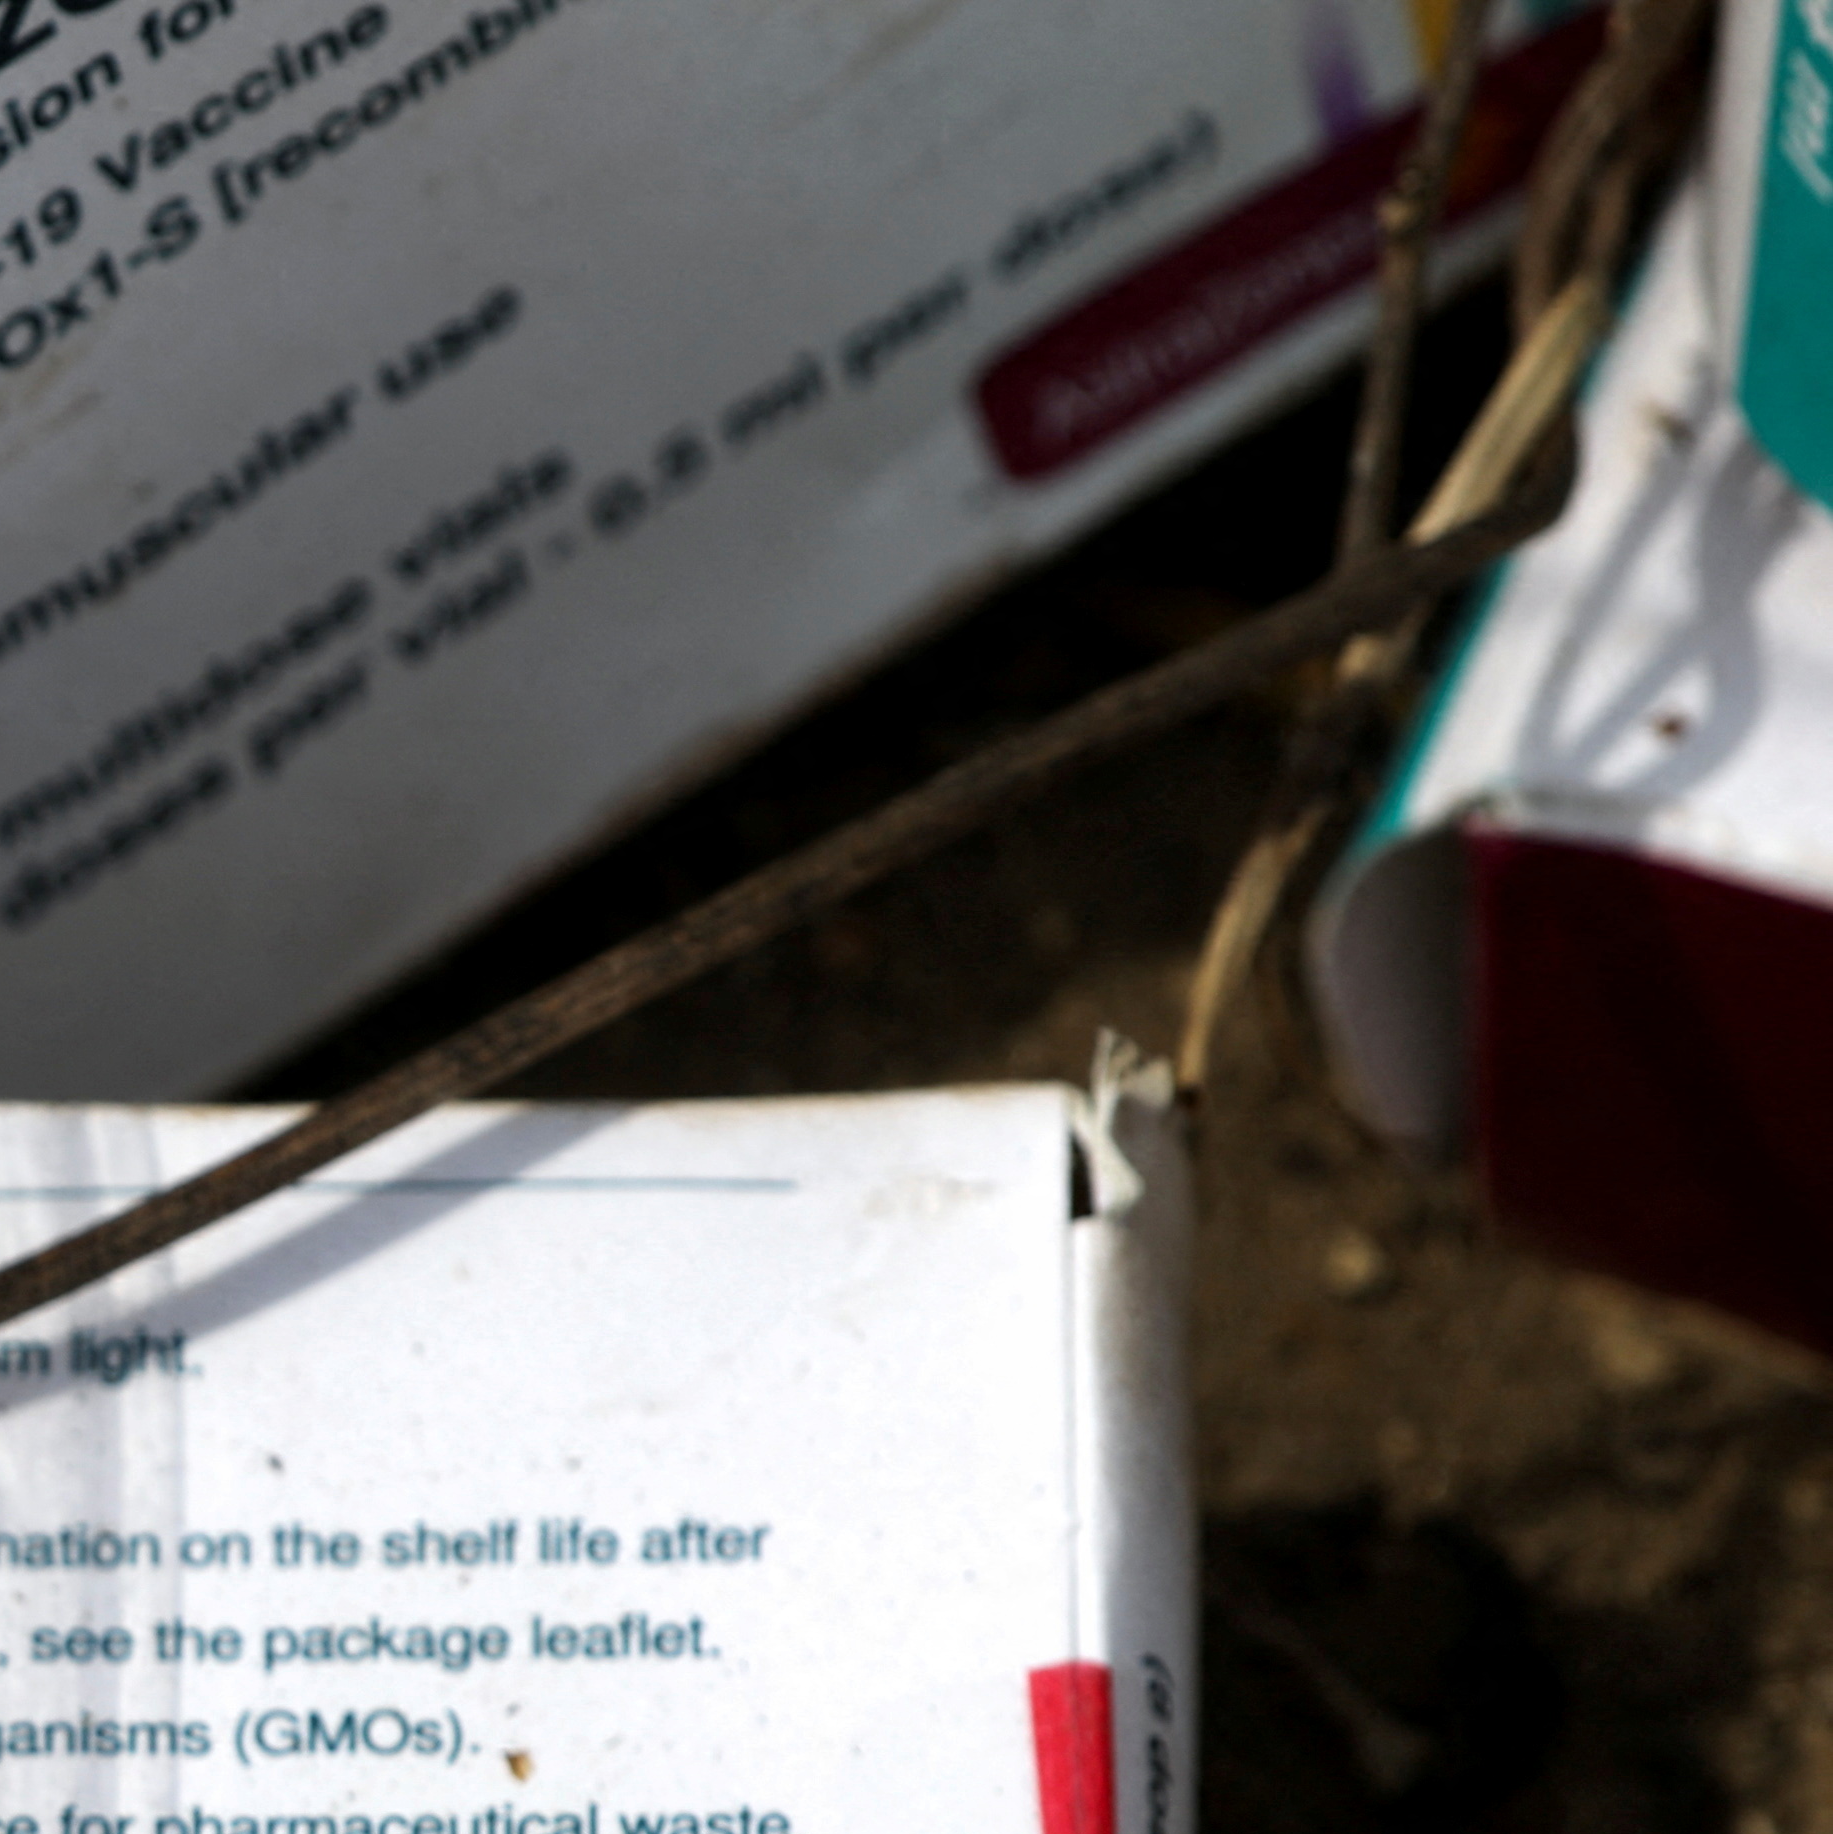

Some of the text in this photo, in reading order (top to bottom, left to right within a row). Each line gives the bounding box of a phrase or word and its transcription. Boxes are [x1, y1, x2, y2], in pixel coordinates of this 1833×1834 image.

[93, 2, 389, 193] Vaccine
[376, 282, 523, 405] use
[69, 1324, 203, 1382] light.
[180, 1529, 249, 1566] on
[274, 1522, 361, 1567] the
[382, 1522, 520, 1567] shelf
[537, 1520, 620, 1566] life
[640, 1520, 773, 1567] after
[31, 1626, 135, 1664] see
[157, 1620, 242, 1663] the
[263, 1615, 510, 1673] package
[530, 1614, 722, 1662] leaflet.
[233, 1707, 481, 1765] (GMOs).
